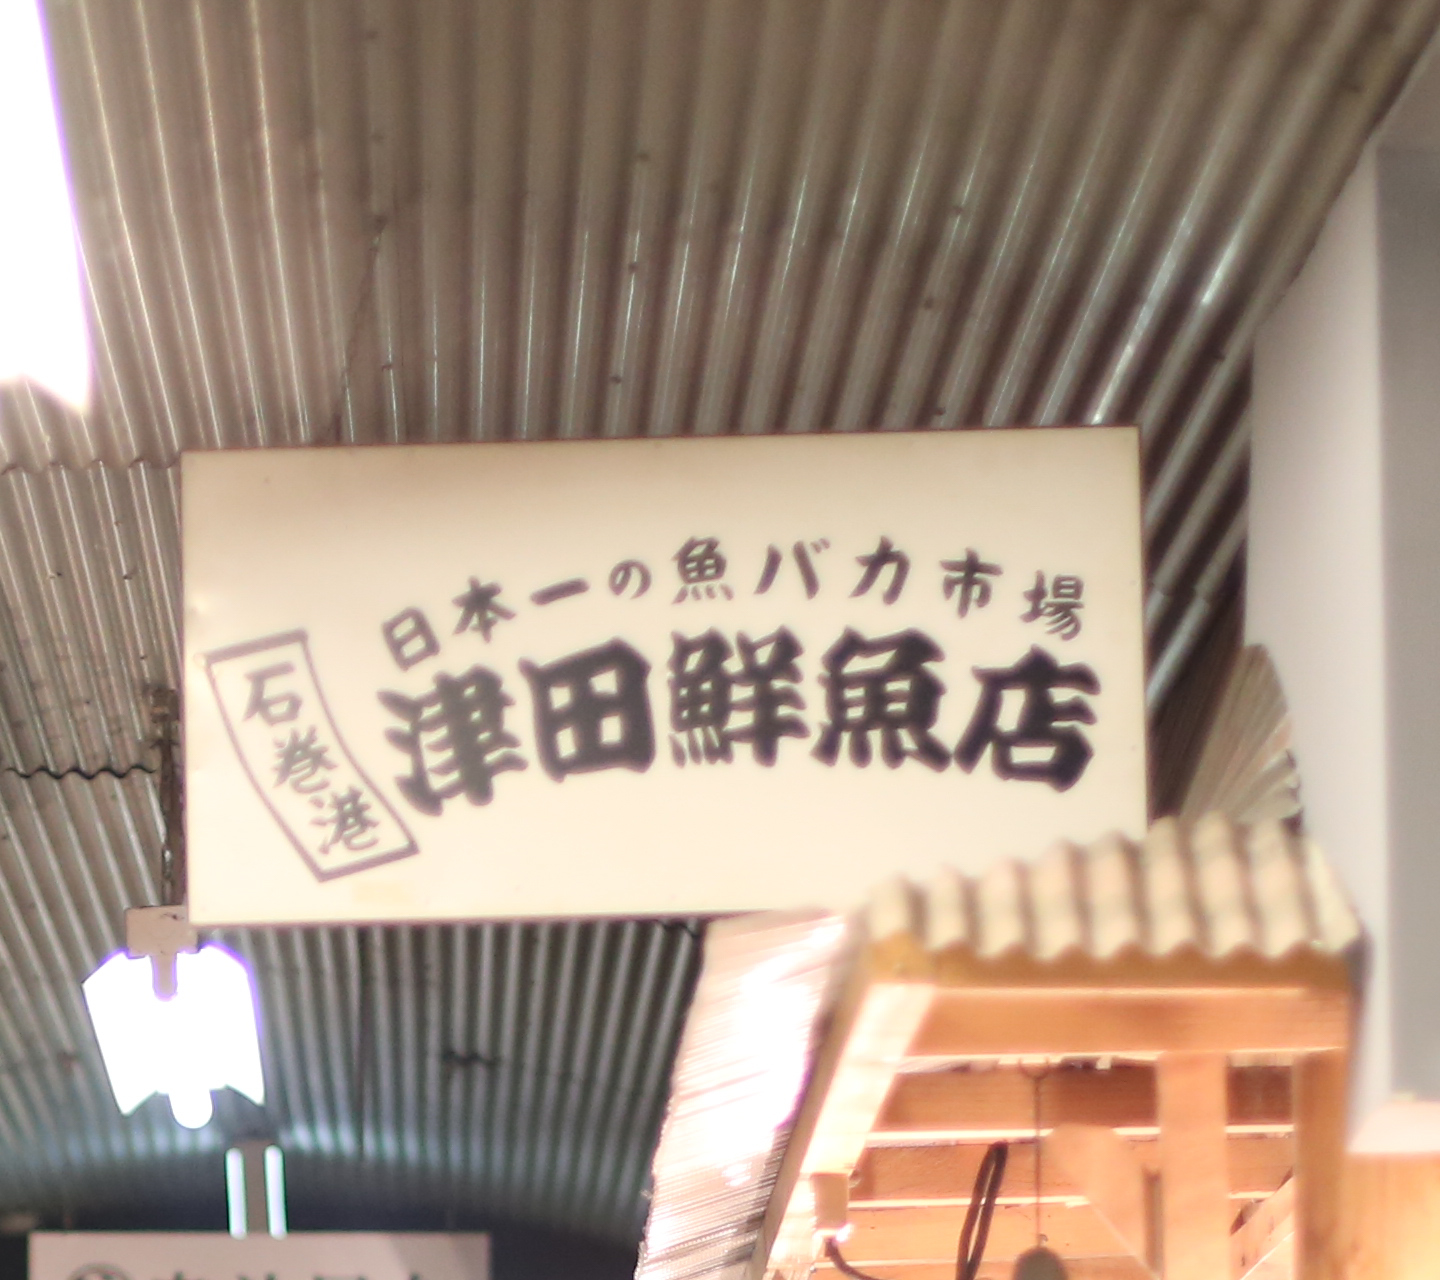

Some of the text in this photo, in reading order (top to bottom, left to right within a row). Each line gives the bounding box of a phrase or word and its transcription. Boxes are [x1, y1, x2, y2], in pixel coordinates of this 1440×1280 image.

[380, 535, 1086, 672] 日本一の魚バカ市場
[239, 660, 382, 860] 石巻港
[377, 624, 1102, 818] 津田鮮魚店
